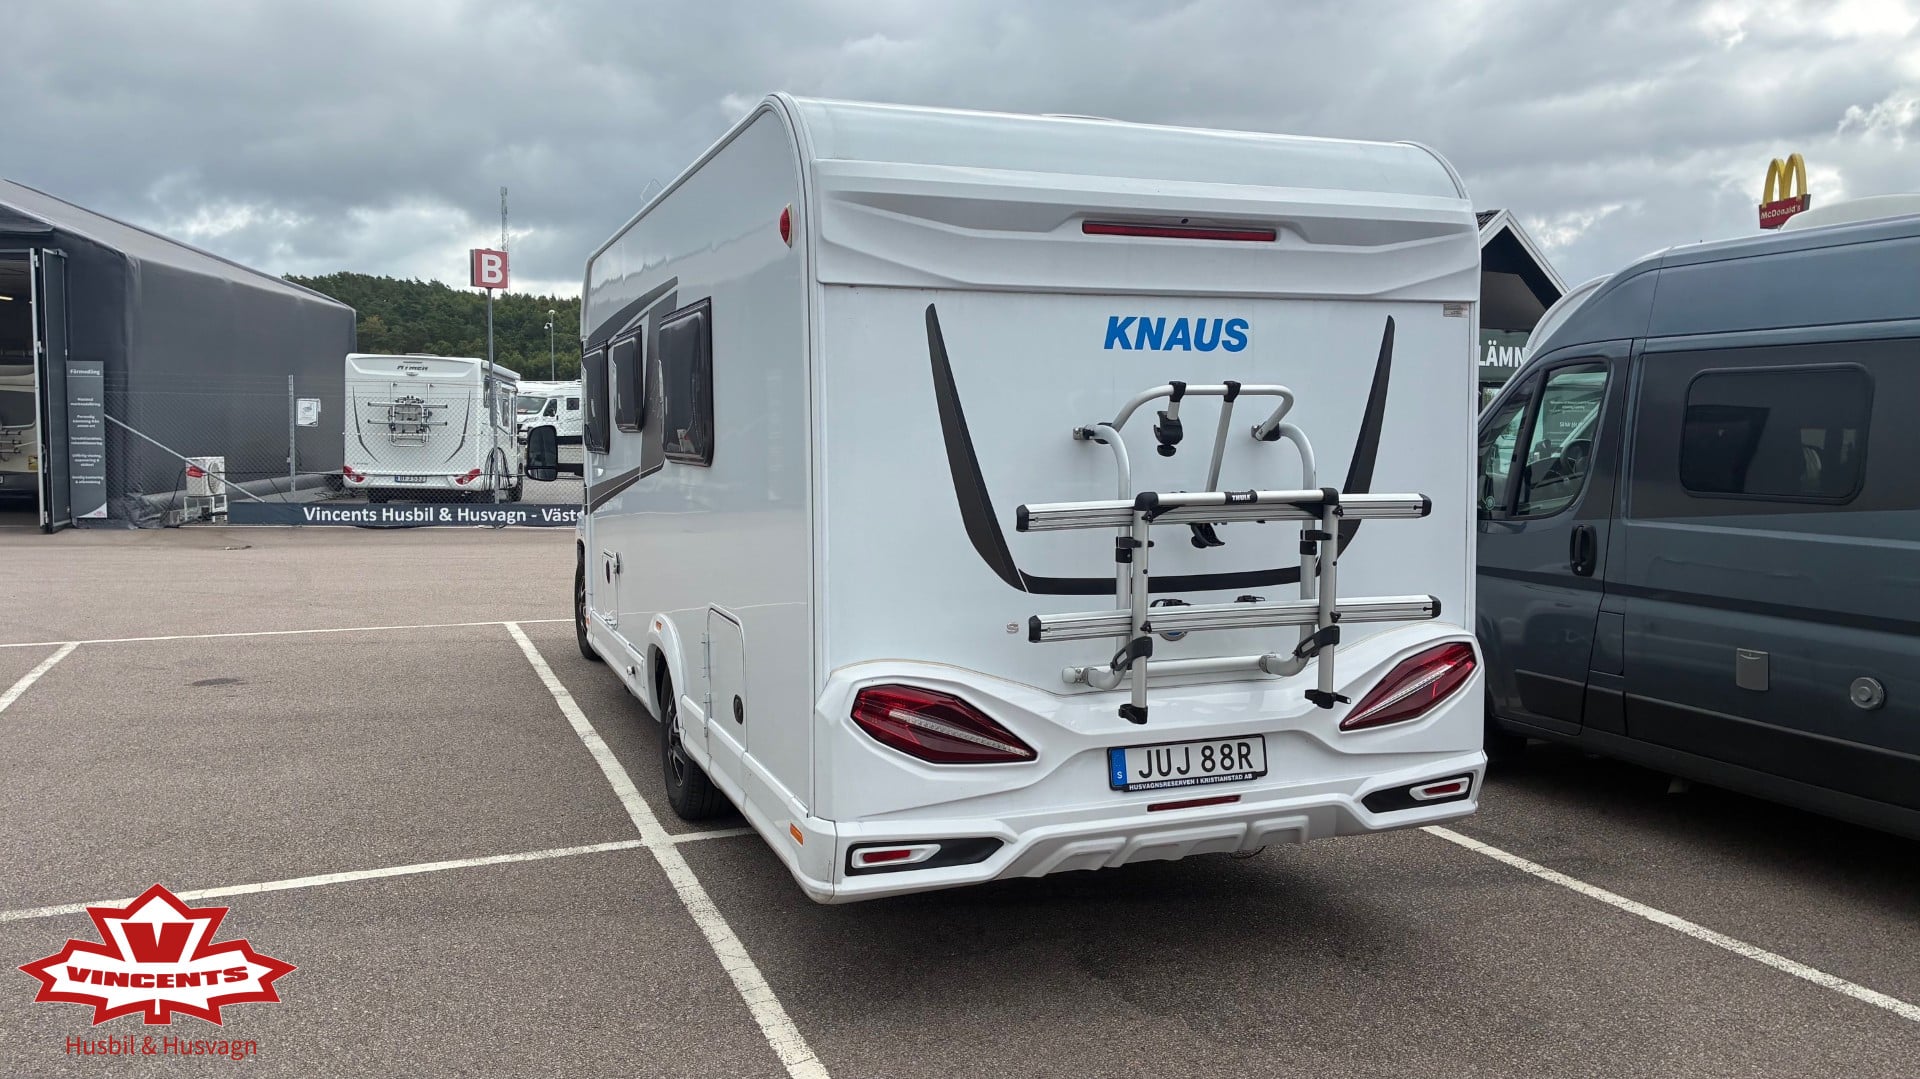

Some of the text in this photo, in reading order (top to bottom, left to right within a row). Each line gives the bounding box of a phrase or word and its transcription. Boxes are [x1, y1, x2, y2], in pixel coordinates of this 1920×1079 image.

[1760, 204, 1801, 219] McDonald's
[481, 253, 503, 284] B
[1104, 316, 1250, 352] KNAUS
[303, 506, 377, 522] Vincents
[382, 505, 434, 522] Husbil
[439, 506, 452, 522] &
[458, 507, 525, 524] Husvagn
[1117, 742, 1253, 779] S JUJ 88R
[1129, 779, 1195, 791] HUSVAGNSRESERVEN
[1200, 774, 1243, 784] KRISTIANSTAD
